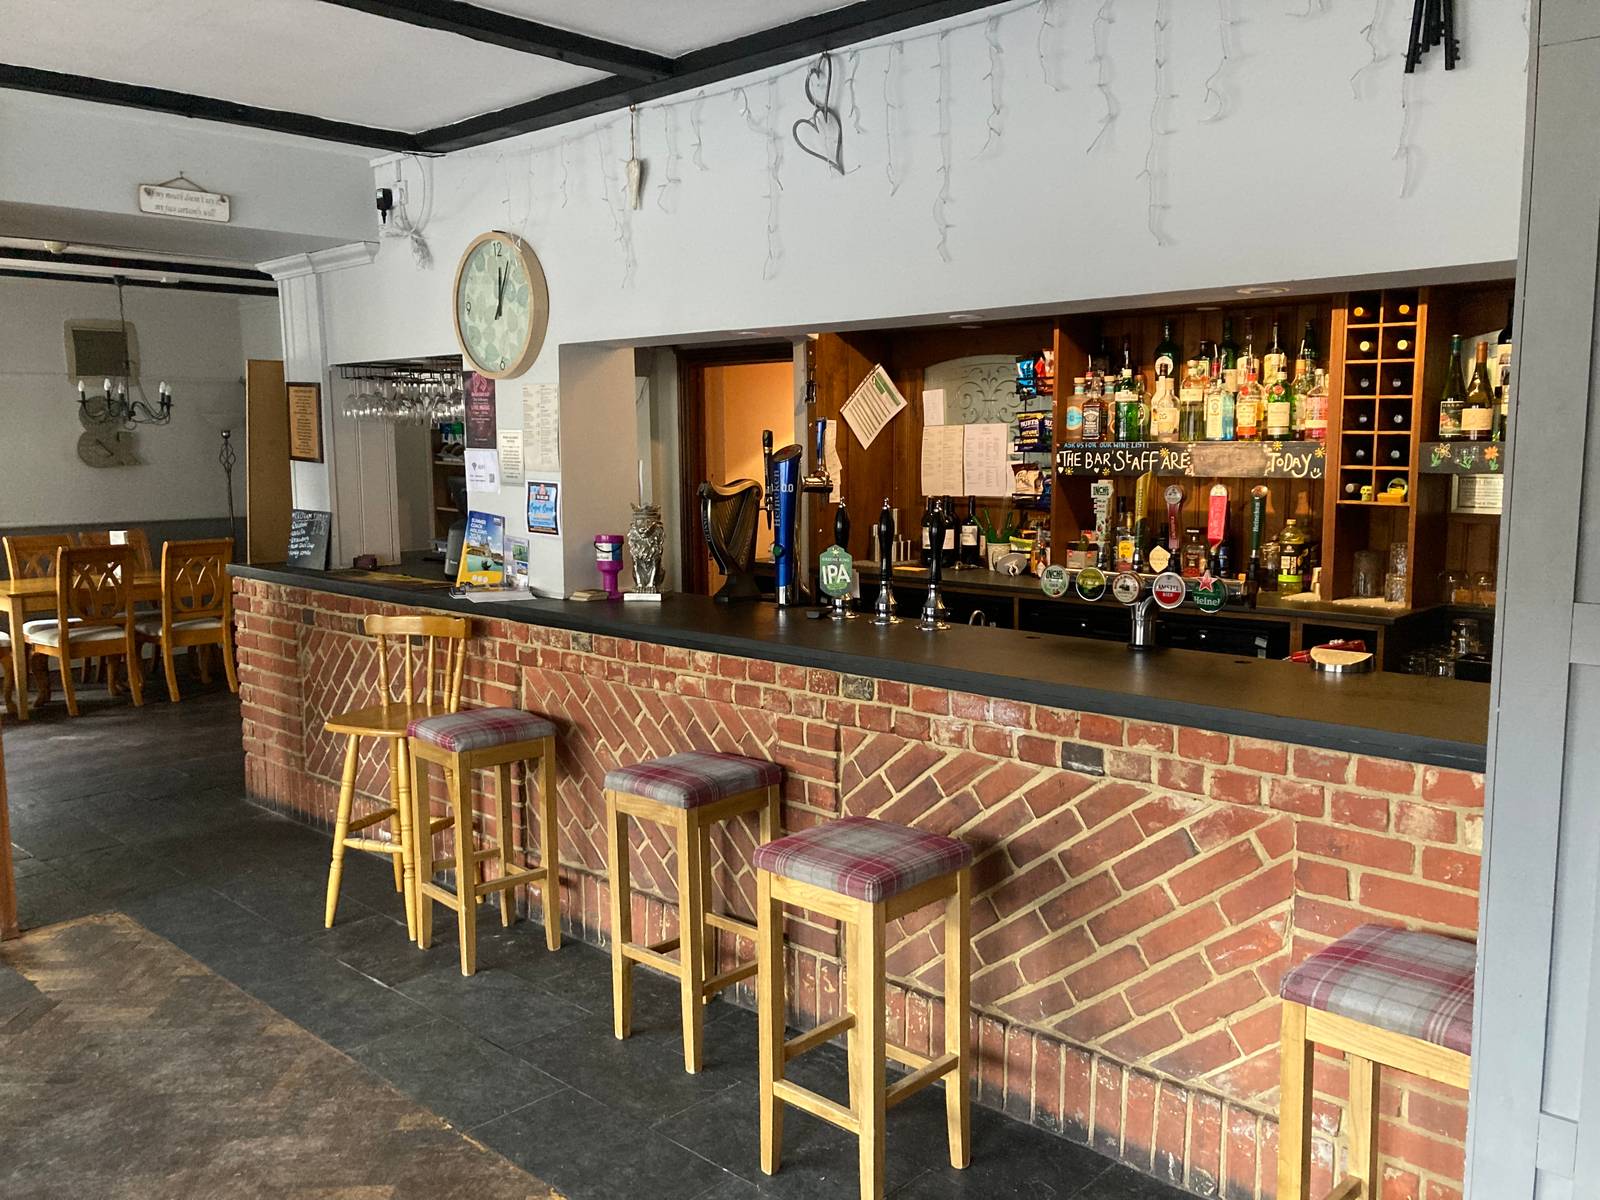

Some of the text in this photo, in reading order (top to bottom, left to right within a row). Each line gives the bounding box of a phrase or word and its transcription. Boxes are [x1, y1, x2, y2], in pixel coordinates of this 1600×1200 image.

[493, 242, 503, 257] 12
[465, 301, 472, 315] 9
[499, 357, 506, 371] 6
[1059, 450, 1081, 467] THE
[1161, 451, 1188, 470] ARE
[773, 470, 781, 527] Heineken
[1253, 501, 1261, 533] Heineken
[822, 564, 851, 585] IPA
[1157, 584, 1180, 592] AMSTEL
